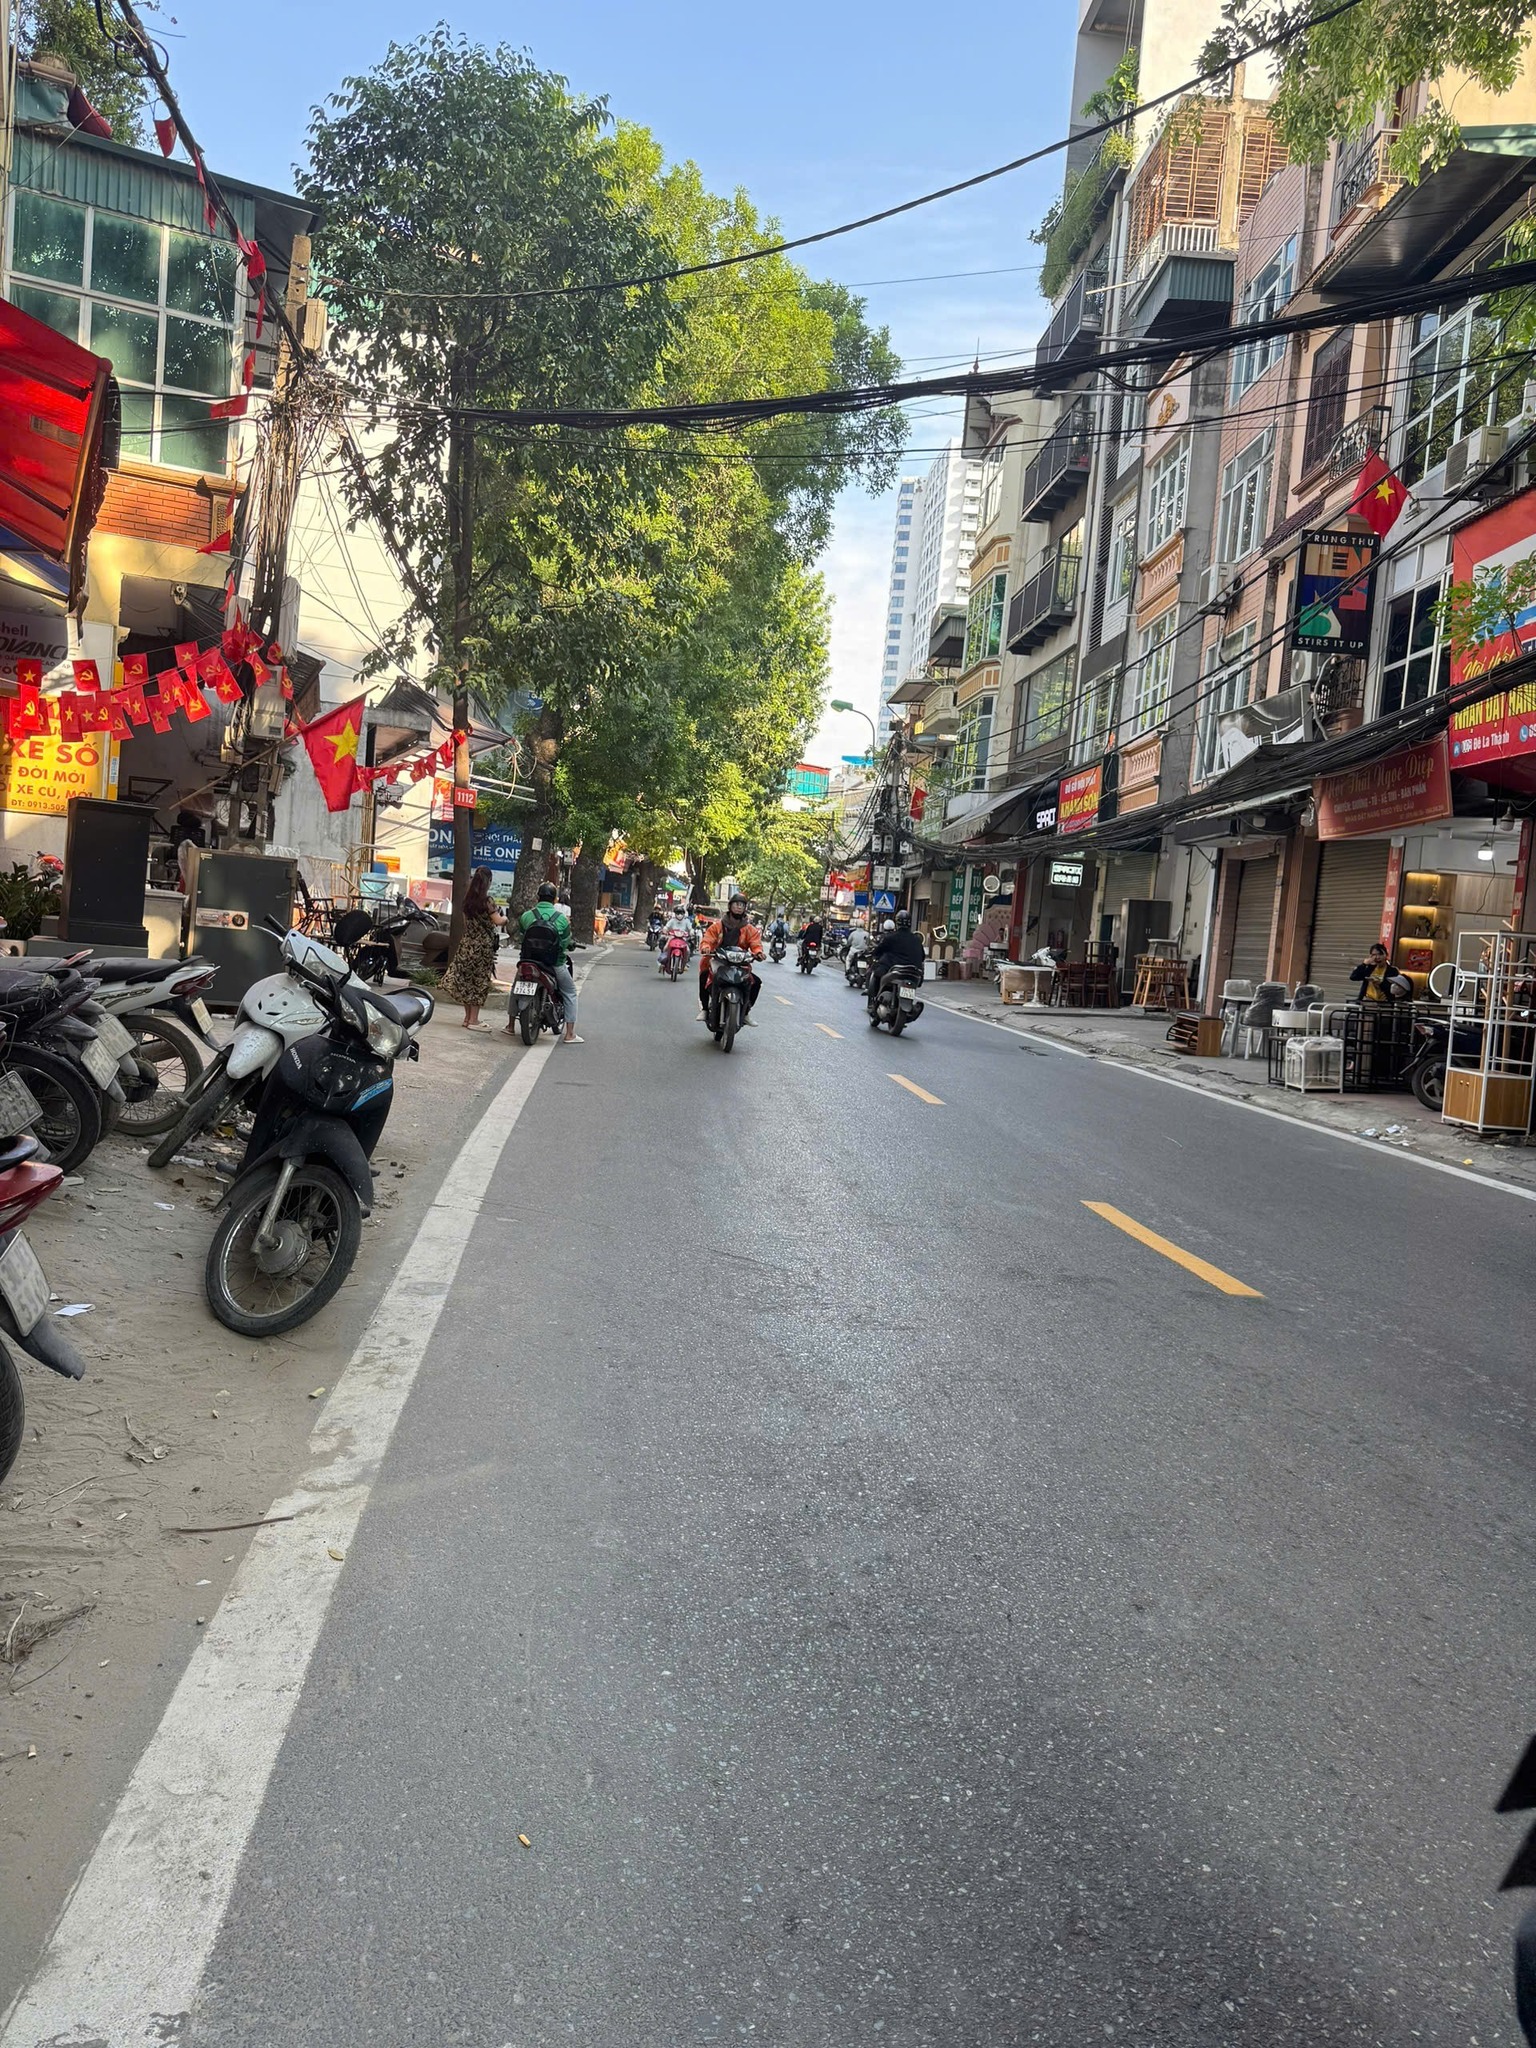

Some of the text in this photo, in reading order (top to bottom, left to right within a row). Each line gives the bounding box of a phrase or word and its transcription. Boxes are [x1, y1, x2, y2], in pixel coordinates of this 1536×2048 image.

[1352, 537, 1374, 546] THU
[0, 622, 29, 637] hell
[1298, 637, 1364, 650] STIRS IT UP
[1482, 734, 1490, 748] La
[13, 740, 100, 767] XE SỐ
[16, 784, 34, 795] XE
[457, 791, 474, 804] 1112
[429, 829, 456, 845] ON
[473, 845, 491, 857] HE
[289, 1047, 303, 1070] HONDA
[330, 1052, 357, 1064] HONDA
